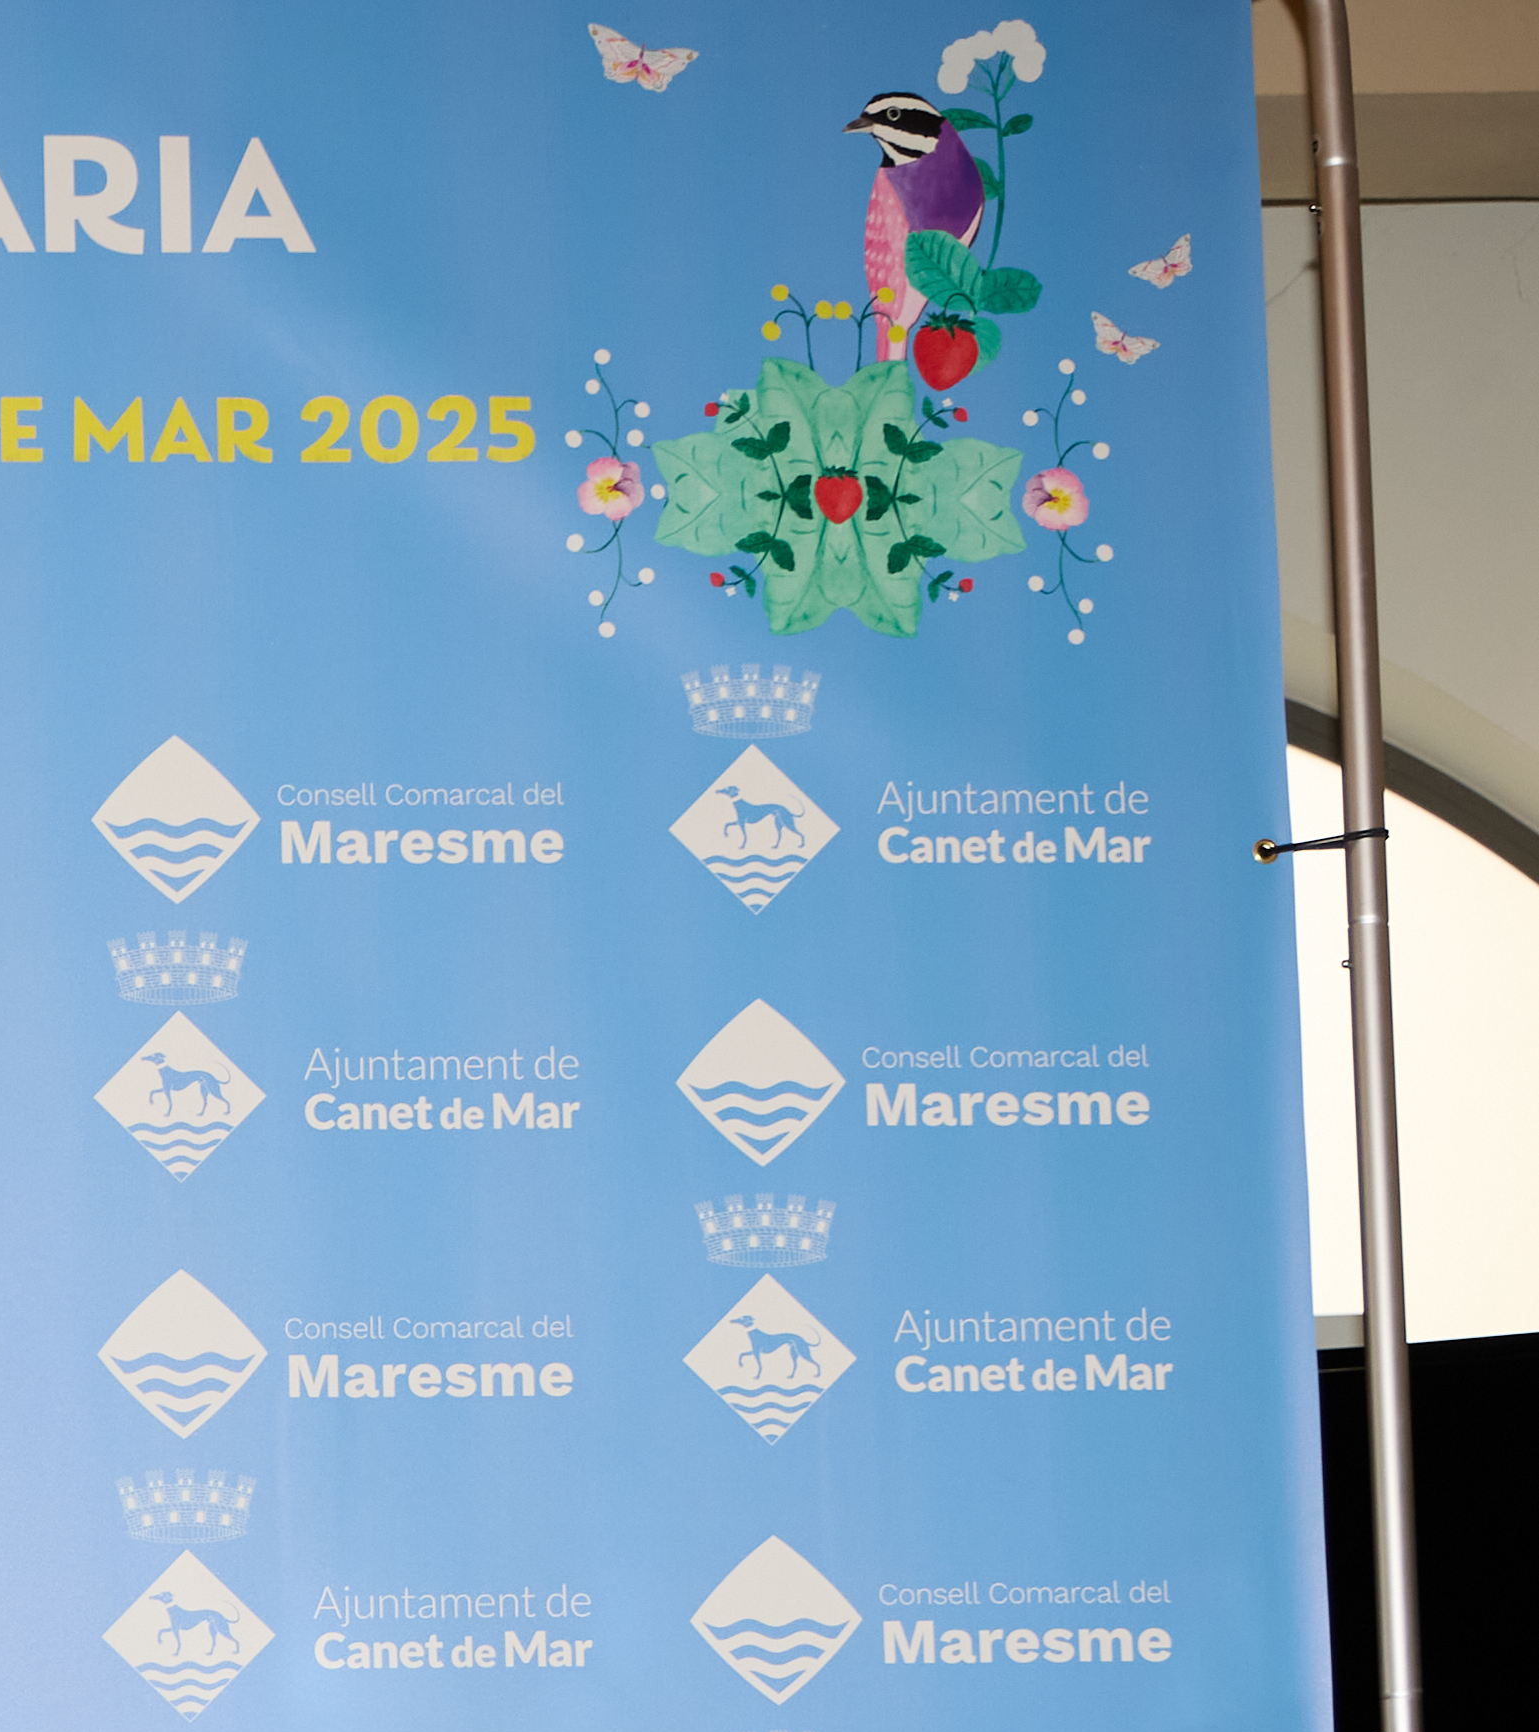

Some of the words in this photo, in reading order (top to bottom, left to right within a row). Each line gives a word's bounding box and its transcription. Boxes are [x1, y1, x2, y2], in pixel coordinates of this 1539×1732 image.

[73, 396, 273, 464] MAR
[300, 394, 536, 464] 2025
[276, 782, 377, 806] Consell
[385, 782, 515, 806] Comarcal
[522, 782, 565, 806] del
[877, 780, 1096, 823] Ajuntament
[1104, 780, 1150, 815] de
[280, 819, 565, 865] Maresme
[877, 825, 1007, 865] Canet
[1011, 830, 1058, 864] de
[1063, 825, 1153, 864] Mar
[861, 1045, 962, 1069] Consell
[969, 1044, 1100, 1069] Comarcal
[1107, 1044, 1150, 1068] del
[865, 1082, 1151, 1127] Maresme
[893, 1309, 1117, 1351] Ajuntament
[1125, 1306, 1172, 1342] de
[894, 1354, 1027, 1394] Canet
[1031, 1358, 1078, 1392] de
[1084, 1352, 1175, 1392] Mar
[878, 1581, 981, 1606] Consell
[988, 1580, 1121, 1605] Comarcal
[1128, 1579, 1171, 1604] del
[882, 1619, 1173, 1665] Maresme
